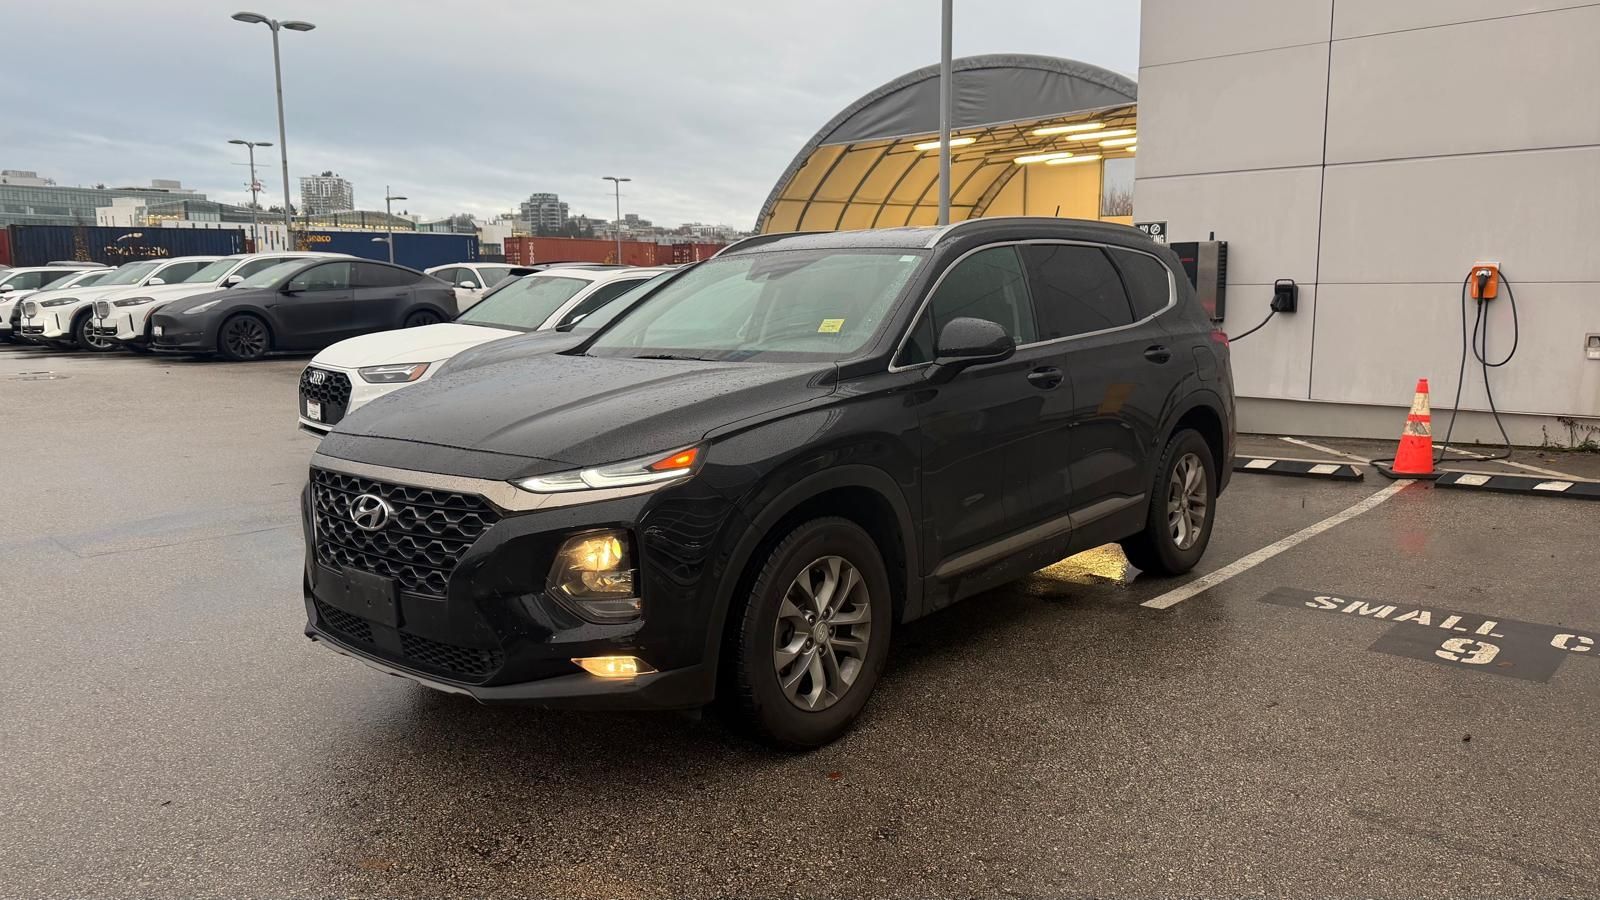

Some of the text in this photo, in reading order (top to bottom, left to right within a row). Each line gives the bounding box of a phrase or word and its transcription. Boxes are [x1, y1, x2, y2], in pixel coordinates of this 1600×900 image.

[1305, 596, 1595, 652] SMALL C
[1435, 638, 1500, 665] 9
